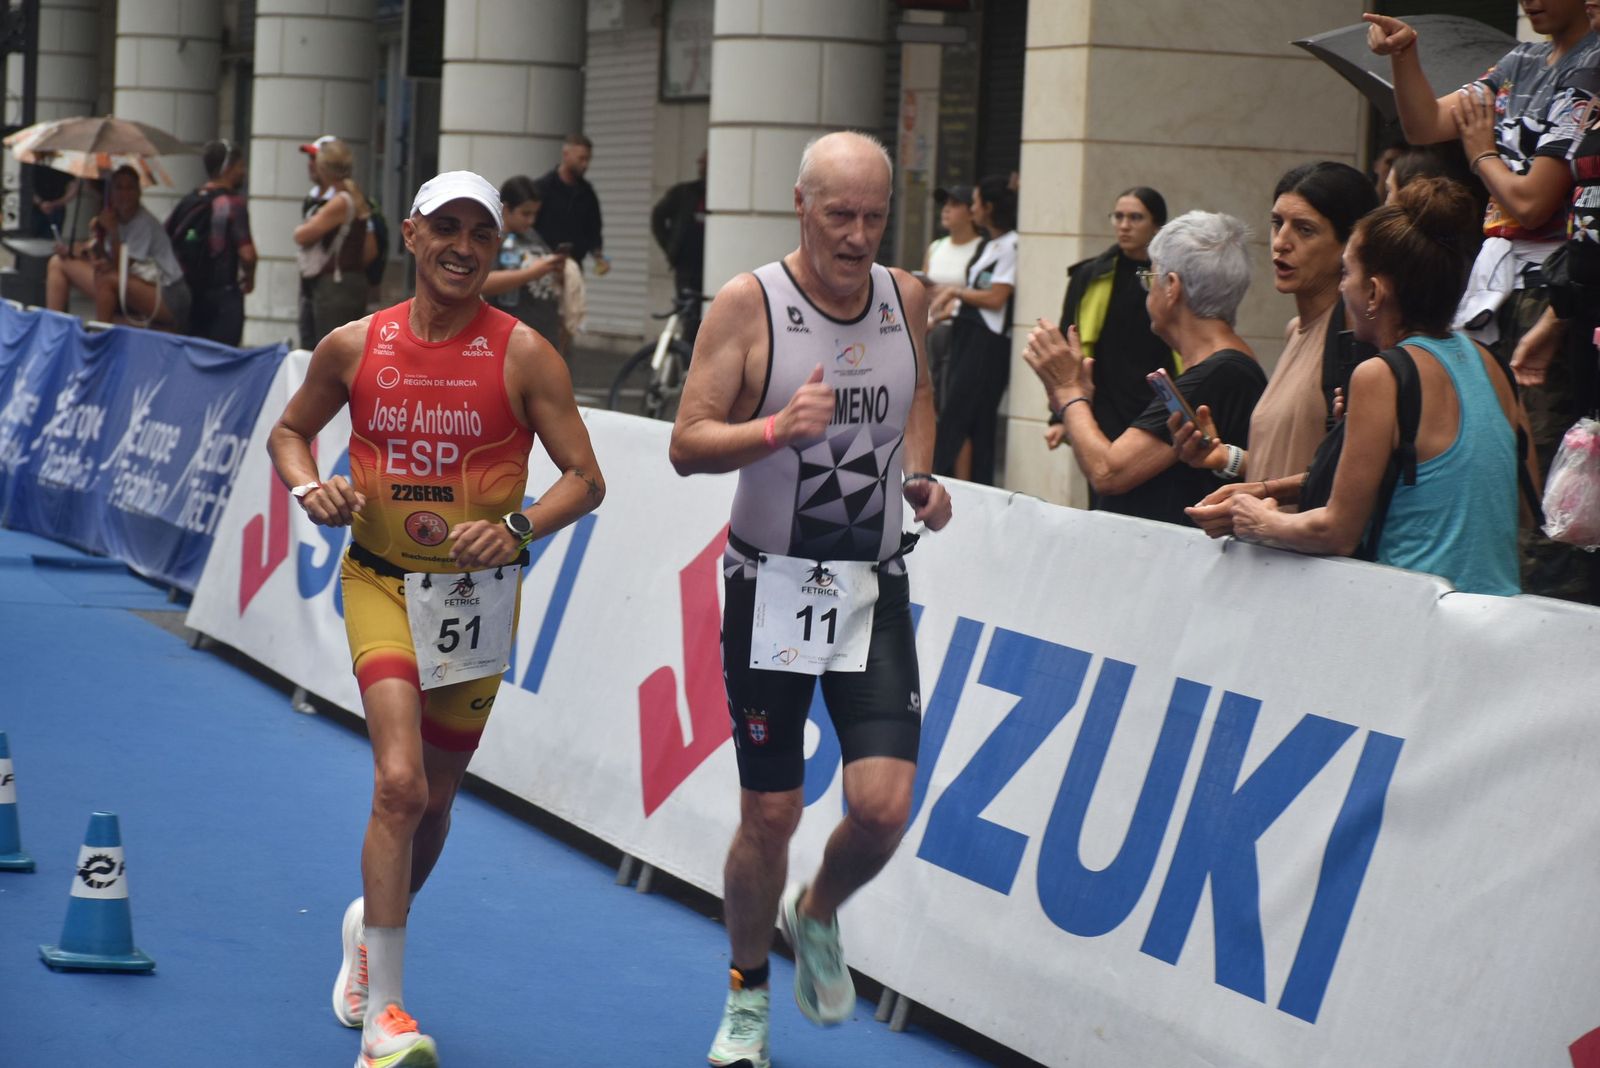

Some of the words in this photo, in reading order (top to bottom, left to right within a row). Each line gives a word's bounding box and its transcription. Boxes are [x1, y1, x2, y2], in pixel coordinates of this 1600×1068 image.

[368, 397, 408, 432] José
[411, 400, 482, 437] Antonio
[829, 385, 889, 426] MENO
[386, 438, 460, 477] ESP
[391, 484, 454, 502] 226ERS
[444, 597, 480, 607] FETRICE
[801, 586, 838, 597] FETRICE
[437, 615, 481, 654] 51
[796, 605, 838, 644] 11
[803, 603, 1406, 1024] UZUKI
